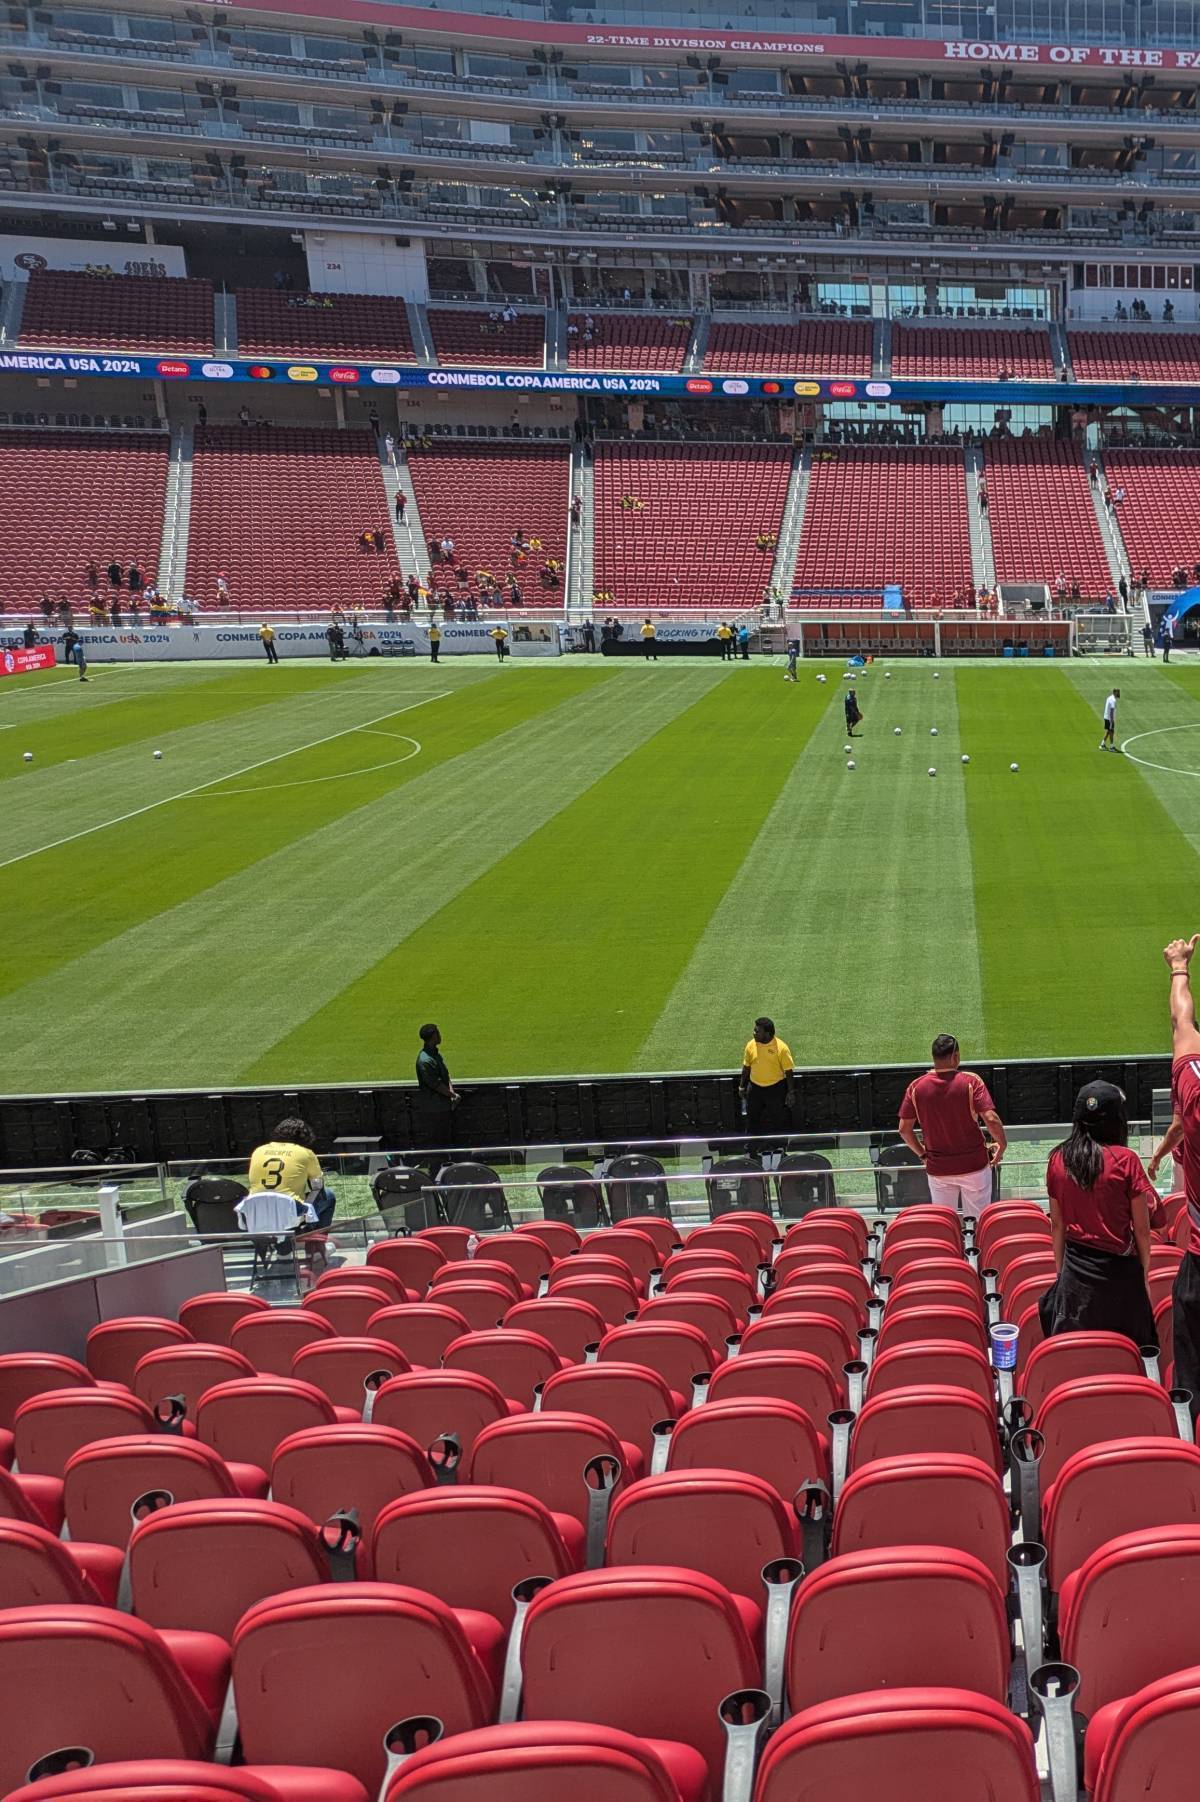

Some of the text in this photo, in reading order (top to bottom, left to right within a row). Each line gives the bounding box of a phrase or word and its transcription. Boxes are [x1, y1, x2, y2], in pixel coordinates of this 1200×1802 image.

[587, 35, 825, 54] 22-TIME DIVISION CHAMPIONS
[944, 42, 1039, 62] HOME
[1049, 47, 1090, 63] OF
[1099, 49, 1163, 65] THE
[70, 357, 100, 372] USA
[103, 359, 141, 373] 2024
[428, 372, 660, 391] CONMEBOL COPA AMERICA USA 2024
[144, 634, 170, 643] 2024
[279, 632, 306, 641] COPA
[378, 630, 402, 639] 2024
[444, 629, 491, 638] CONMEB
[657, 629, 698, 638] ROCKING
[261, 1157, 285, 1190] 3
